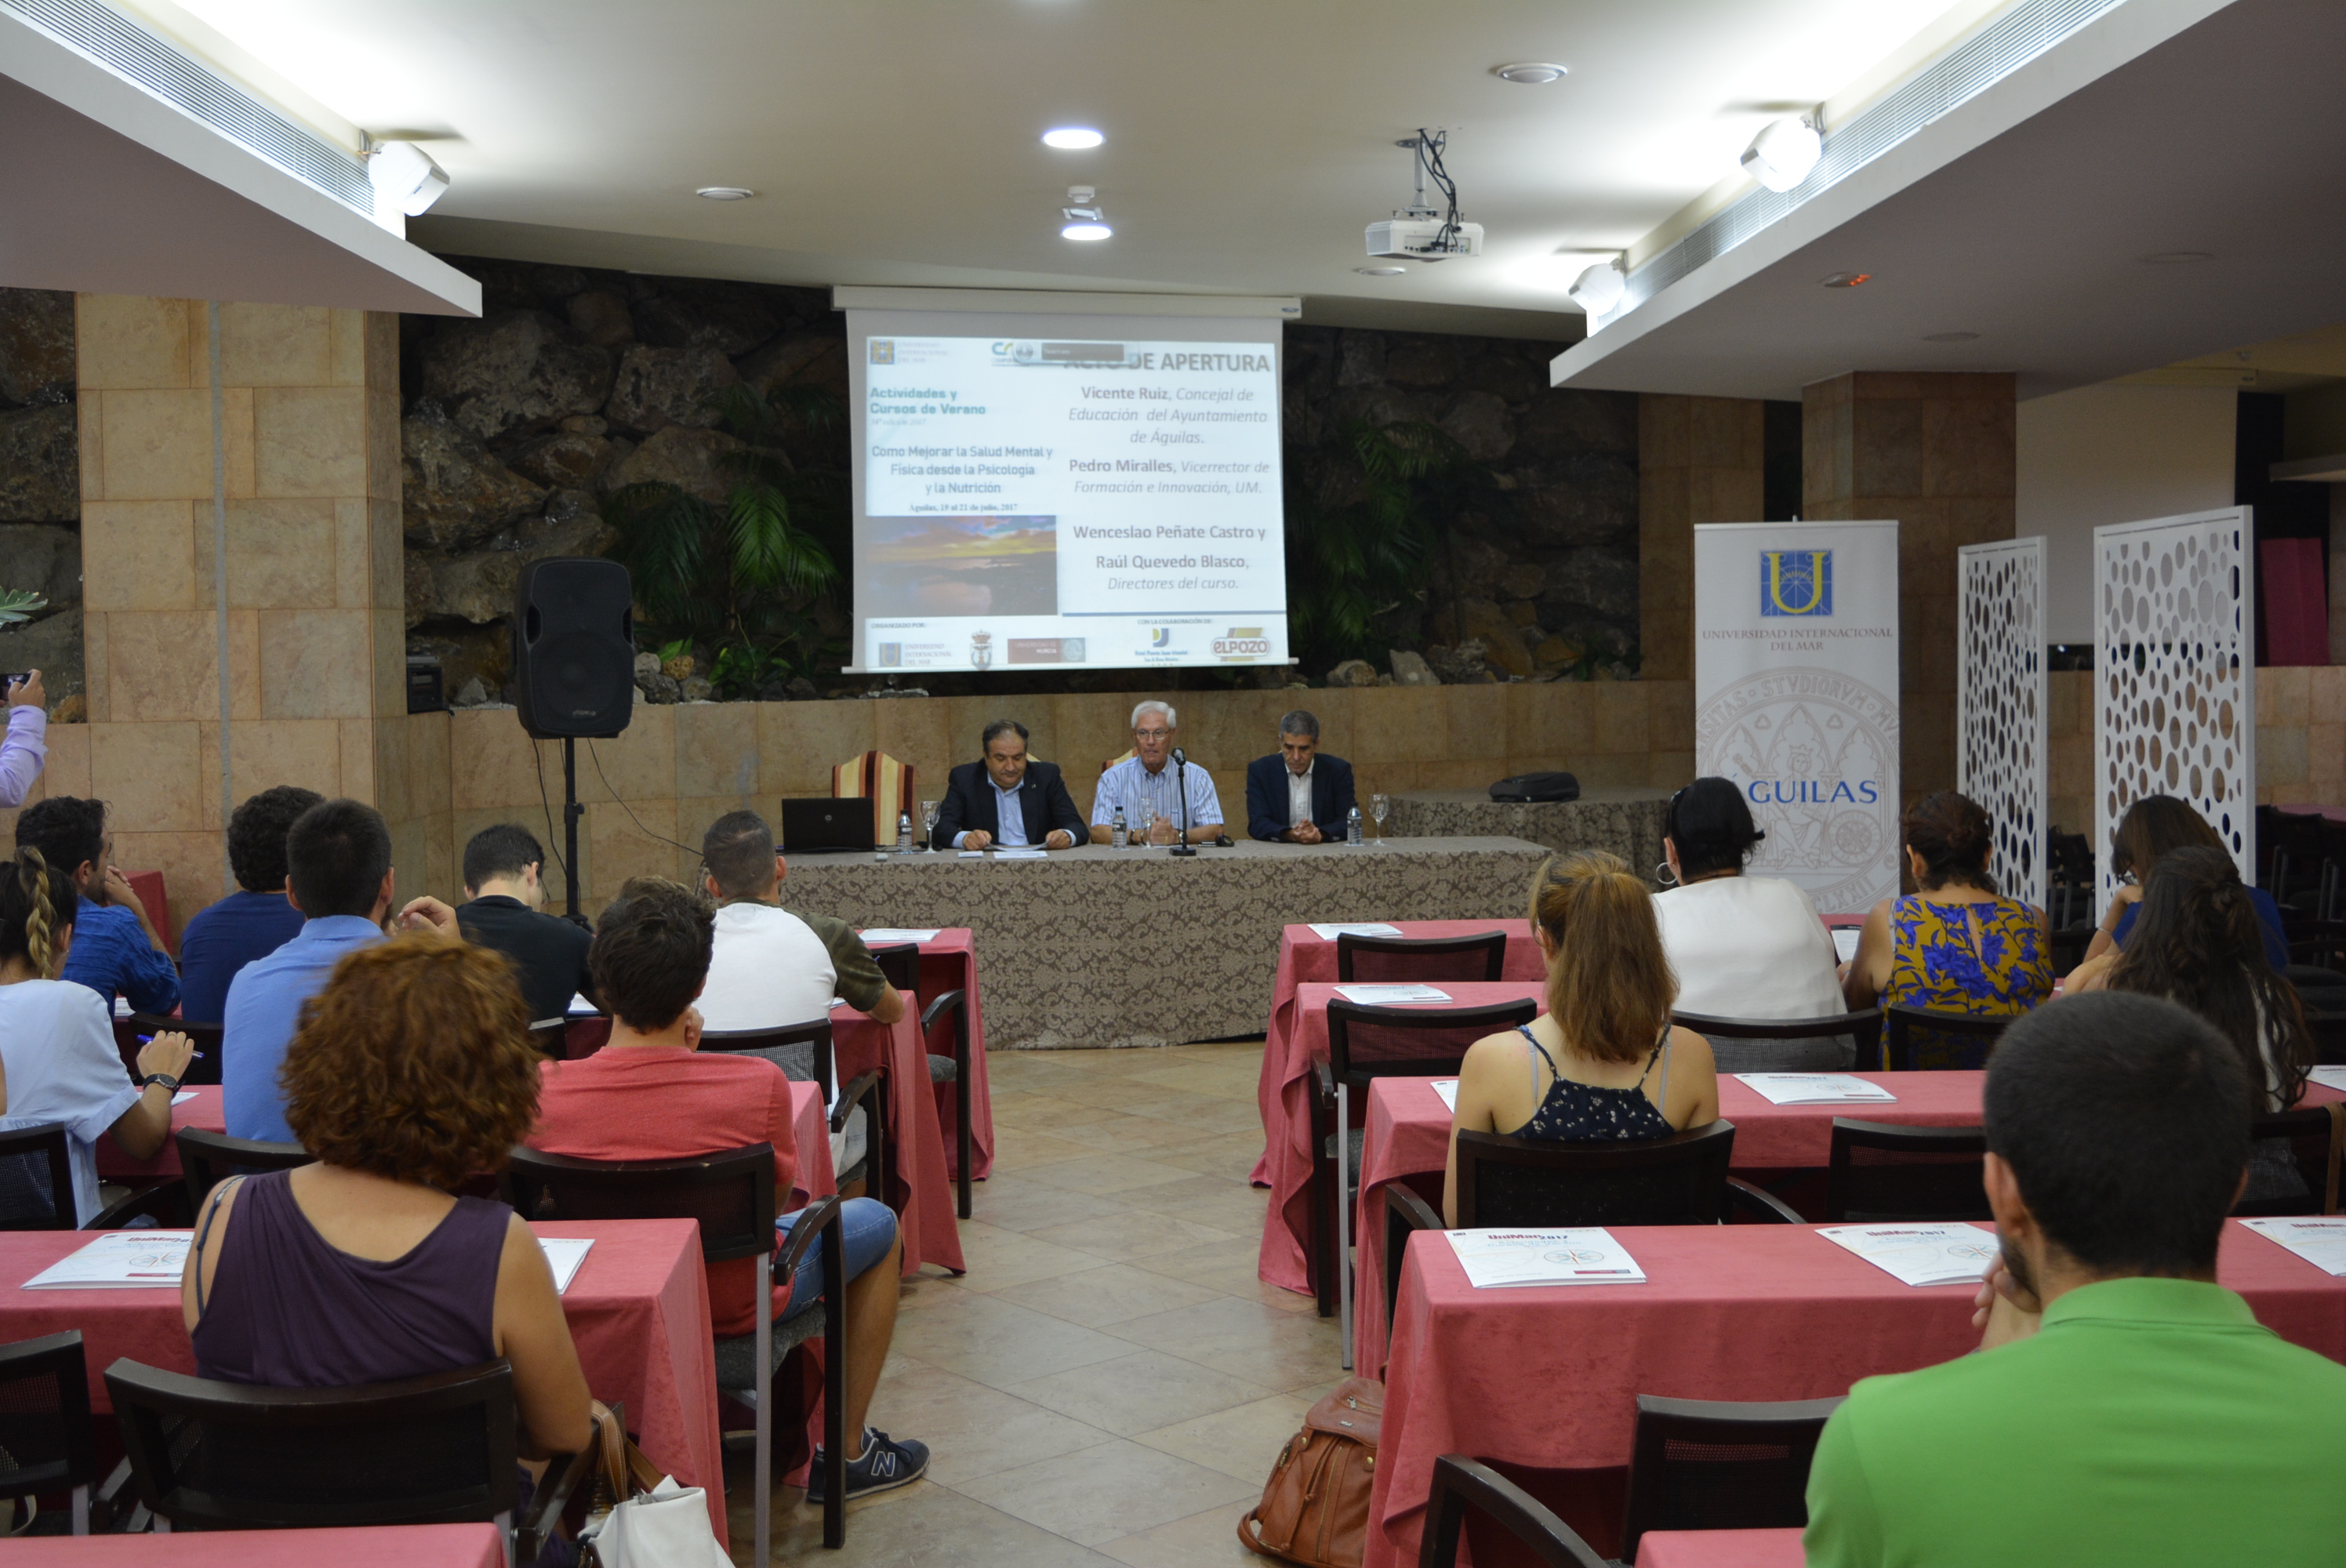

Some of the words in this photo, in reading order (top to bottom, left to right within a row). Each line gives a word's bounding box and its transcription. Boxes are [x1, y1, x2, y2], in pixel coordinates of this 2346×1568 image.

[1160, 354, 1270, 372] APERTURA
[870, 387, 946, 399] Actividades
[950, 390, 957, 401] y
[1081, 387, 1135, 400] Vicente
[1138, 387, 1173, 401] Ruiz,
[1175, 388, 1233, 405] Concejal
[1237, 388, 1254, 401] de
[870, 403, 917, 415] Cursos
[921, 403, 937, 415] de
[941, 403, 986, 415] Verano
[1068, 407, 1138, 422] Educación
[1146, 408, 1167, 422] del
[1170, 408, 1268, 426] Ayuntamiento
[1129, 430, 1147, 445] de
[1149, 428, 1205, 448] Águilas.
[872, 445, 905, 458] Como
[908, 445, 953, 460] Mejorar
[957, 445, 967, 457] la
[970, 445, 1003, 458] Salud
[1005, 446, 1044, 458] Mental
[1045, 448, 1053, 459] y
[890, 463, 924, 475] Física
[926, 463, 962, 475] desde
[964, 464, 975, 475] la
[977, 463, 1035, 478] Psicología
[1069, 459, 1111, 473] Pedro
[1116, 459, 1177, 474] Miralles,
[1181, 460, 1251, 474] Vicerrector
[1255, 461, 1269, 474] de
[925, 484, 932, 495] y
[934, 482, 946, 493] la
[947, 481, 1001, 494] Nutrición
[1074, 480, 1143, 494] Formación
[1146, 483, 1155, 493] e
[1157, 480, 1232, 495] Innovación,
[1235, 481, 1262, 495] UM.
[980, 503, 1000, 513] julio,
[1073, 524, 1152, 539] Wenceslao
[1157, 524, 1205, 539] Peñate
[1209, 524, 1255, 539] Castro
[1258, 528, 1266, 541] y
[1096, 554, 1128, 569] Raúl
[1132, 554, 1197, 570] Quevedo
[1200, 555, 1250, 570] Blasco,
[1107, 576, 1175, 590] Directores
[1178, 577, 1198, 590] del
[1201, 579, 1240, 590] curso.
[1702, 629, 1787, 640] UNIVERSIDAD
[1790, 628, 1893, 639] INTERNACIONAL
[1770, 641, 1794, 652] DEL
[1796, 641, 1824, 652] MAR
[1731, 774, 1879, 804] GUILAS
[871, 1450, 896, 1477] N
